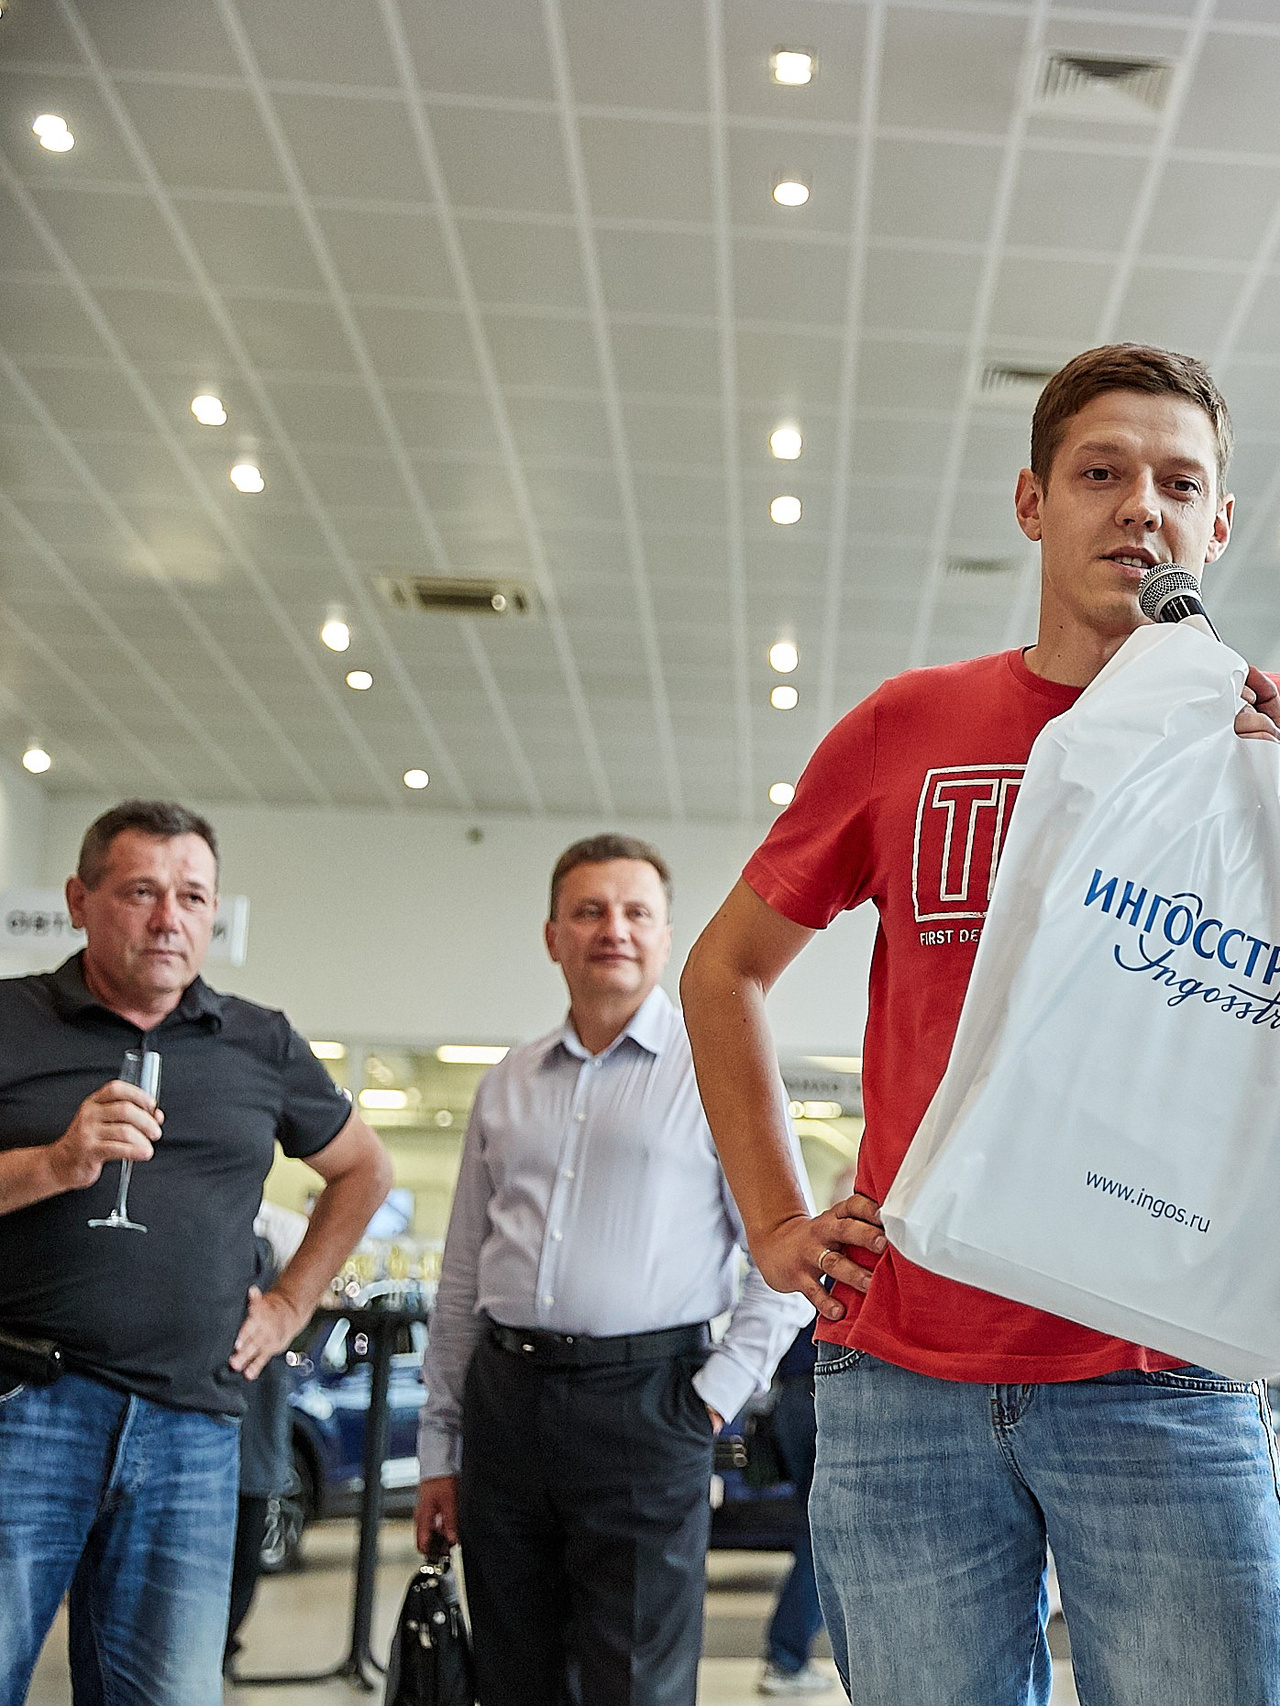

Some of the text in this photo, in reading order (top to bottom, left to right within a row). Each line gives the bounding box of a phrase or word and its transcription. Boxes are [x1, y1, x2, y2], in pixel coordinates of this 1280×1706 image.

[919, 928, 984, 946] FIRST DE
[1086, 1171, 1211, 1233] www.ingos.ru
